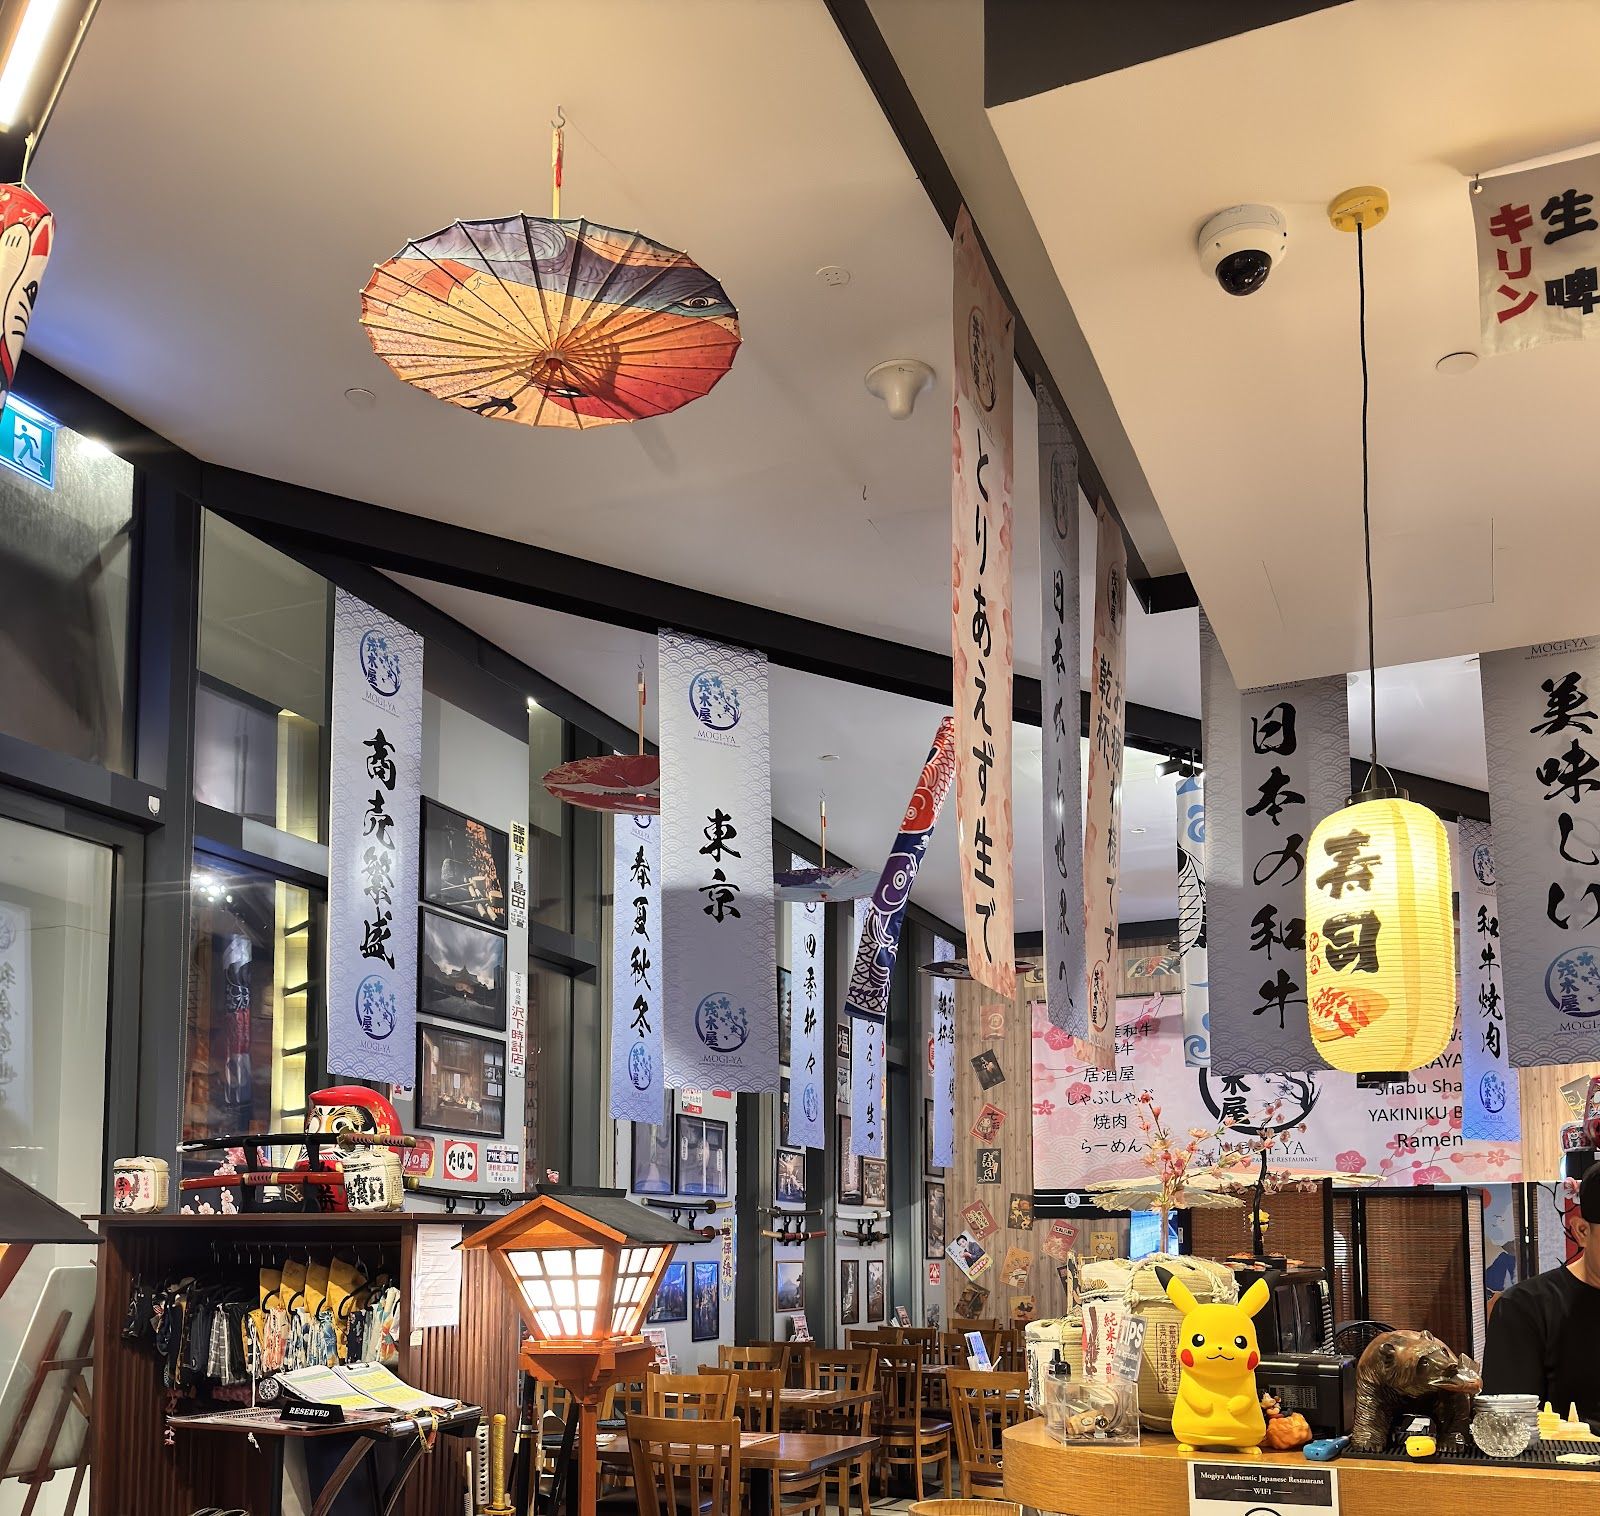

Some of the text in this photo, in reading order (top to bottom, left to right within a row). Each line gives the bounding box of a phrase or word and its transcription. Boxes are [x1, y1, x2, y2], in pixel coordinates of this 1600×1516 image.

[1489, 203, 1539, 324] キリン
[366, 635, 379, 686] 茂木屋
[1531, 638, 1588, 655] MOGI-YA
[698, 678, 712, 724] 茂木屋
[972, 428, 996, 964] とりあえず生で
[697, 730, 736, 744] MOGI-YA
[1051, 569, 1074, 1007] 日本から世界へ
[1529, 671, 1600, 930] 美味しい
[360, 729, 399, 970] 商売繁盛
[698, 808, 742, 923] 東京
[1245, 702, 1308, 1029] 日本の和牛
[1315, 828, 1383, 976] 寿司
[630, 845, 652, 1038] 春夏秋冬
[1476, 905, 1504, 1059] 和牛焼肉
[1557, 959, 1580, 1013] 茂木屋
[362, 983, 374, 1033] 茂木屋
[704, 1001, 719, 1047] 茂木屋
[511, 1006, 525, 1065] 沢下時計店
[703, 1054, 743, 1065] MOGI-YA
[1083, 1066, 1136, 1083] 居酒屋
[1067, 1088, 1154, 1106] しゃぶしゃぶ
[1219, 1075, 1251, 1124] 木屋
[1433, 1079, 1462, 1093] Sha
[1093, 1113, 1127, 1130] 焼肉
[1368, 1106, 1447, 1121] YAKINIKU
[448, 1150, 473, 1170] たばこ
[1081, 1139, 1143, 1154] らーめん
[1398, 1133, 1463, 1148] Ramen
[982, 1152, 996, 1181] 寿司
[1119, 1317, 1144, 1349] TIPS
[289, 1406, 330, 1418] RESERVED
[1200, 1471, 1324, 1485] Mogiya Authentic Japanese Restaurant
[1253, 1487, 1272, 1495] WIFI
